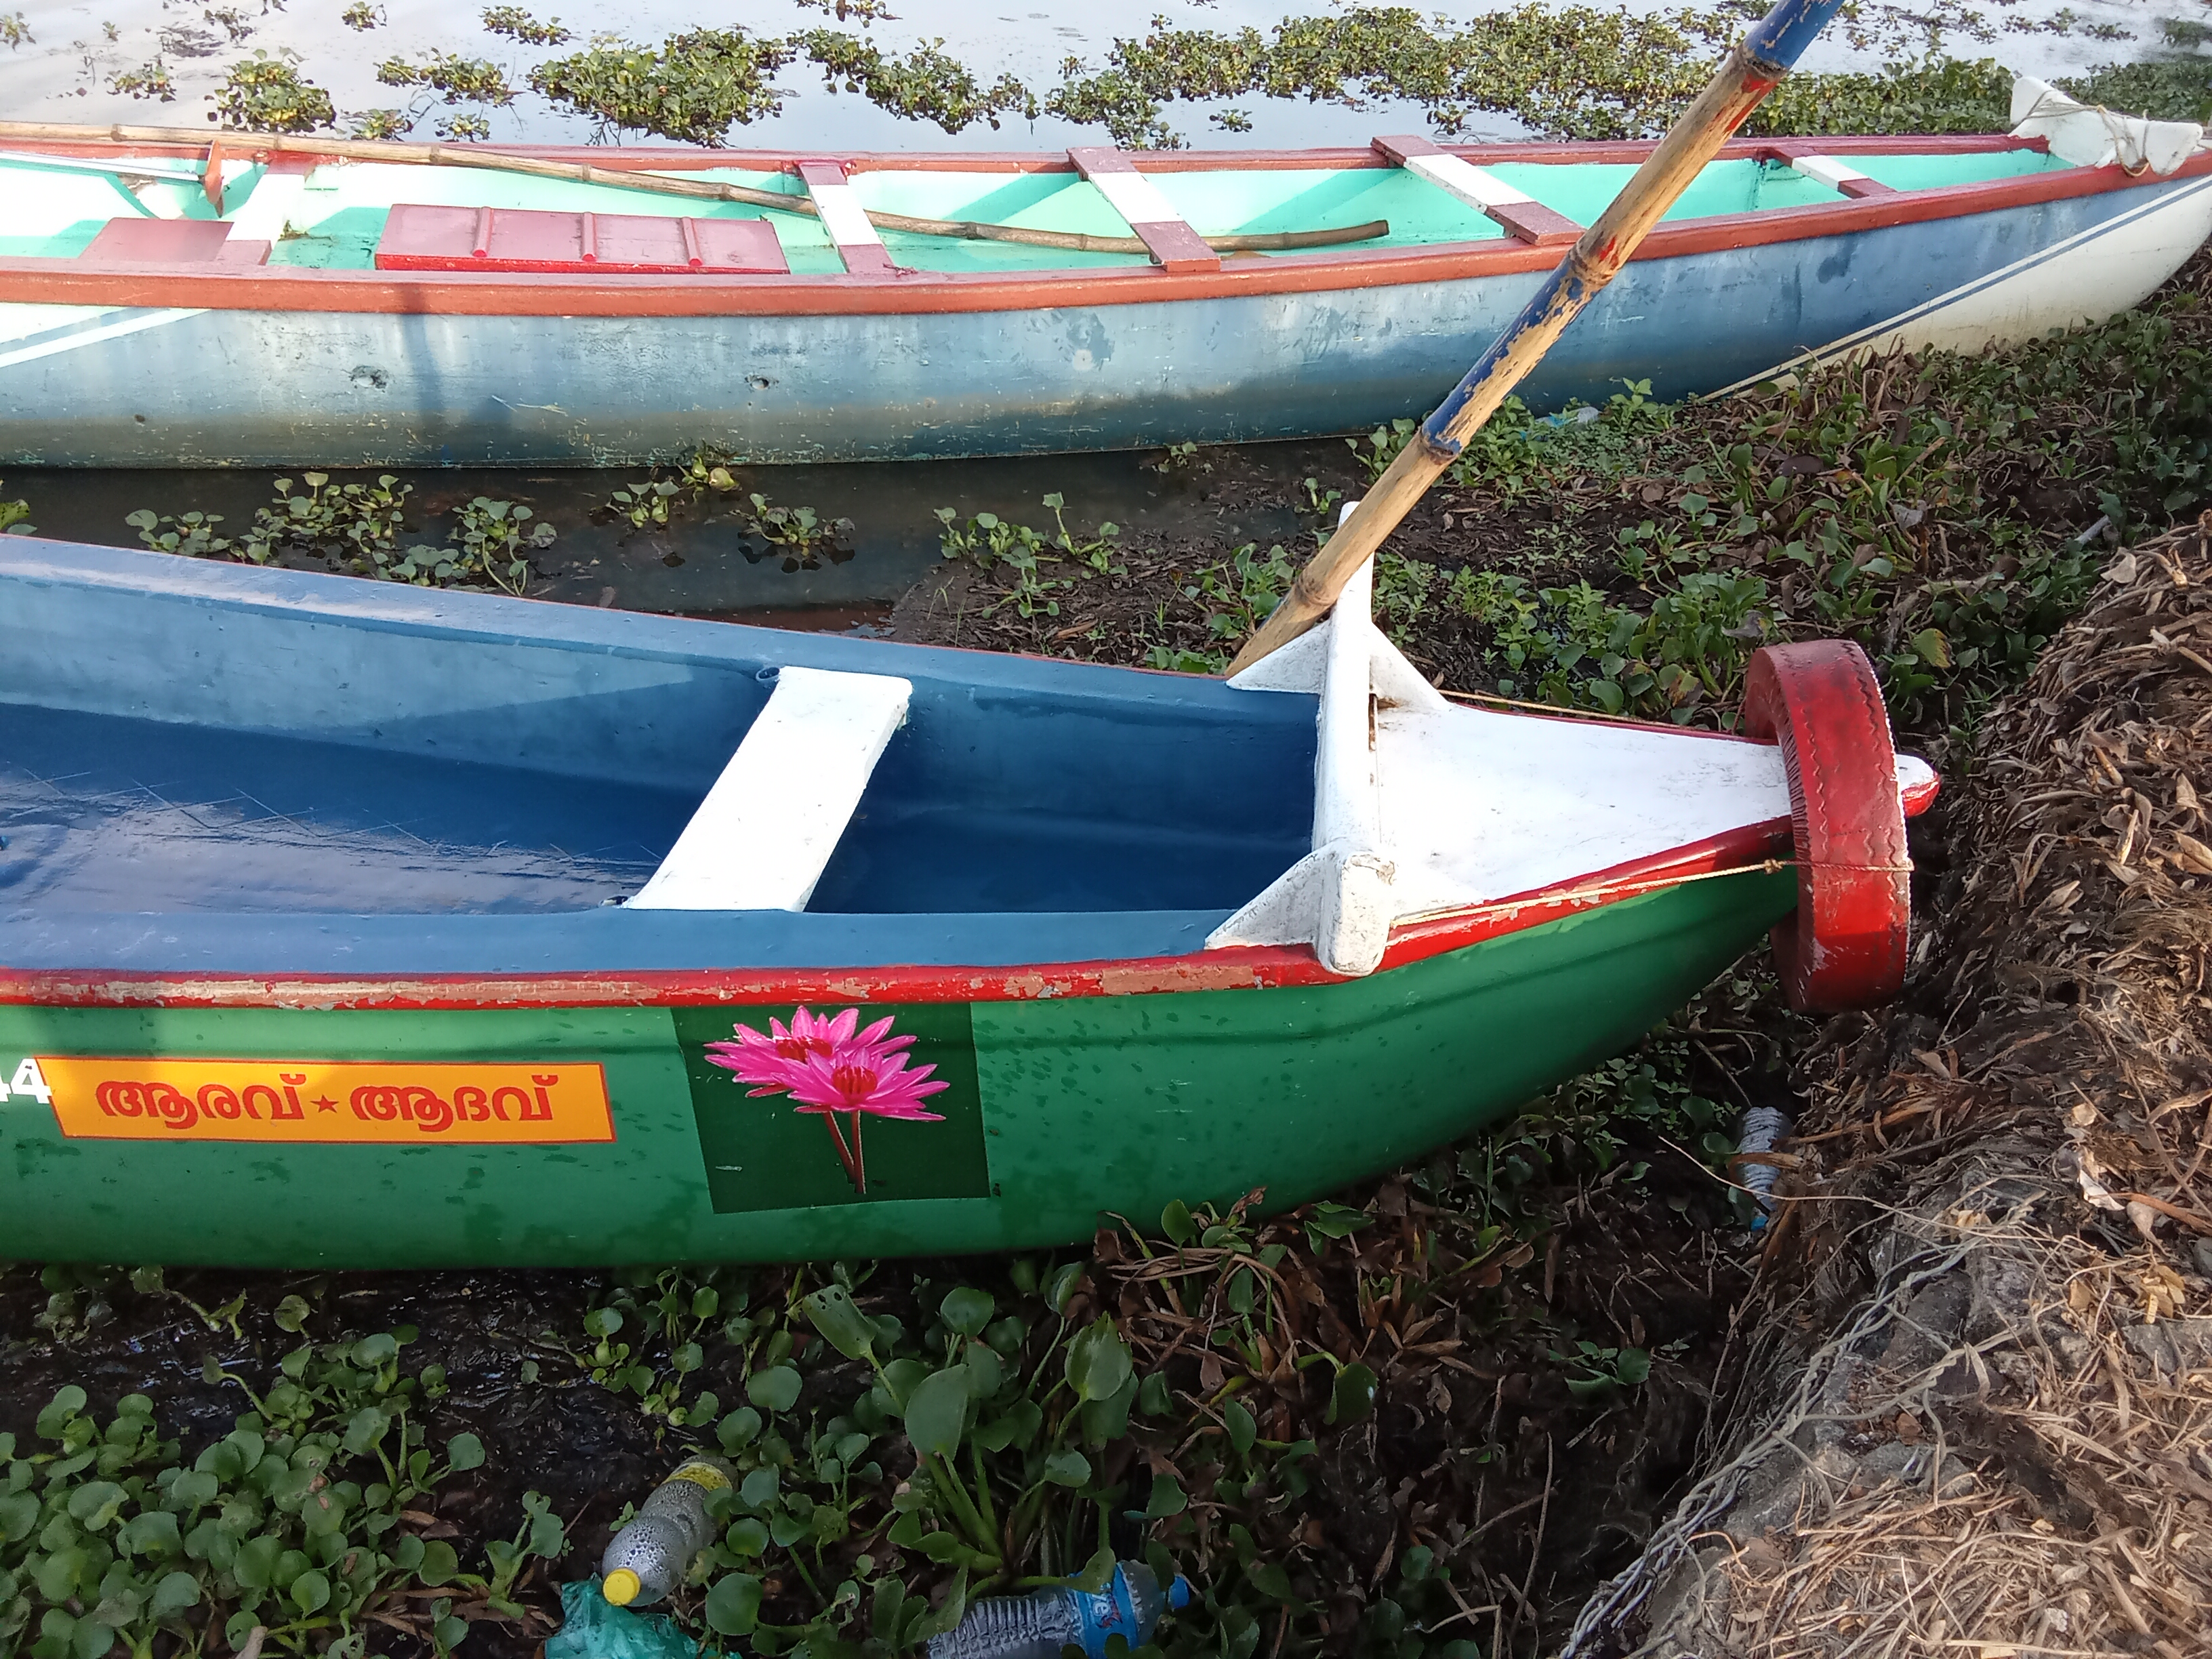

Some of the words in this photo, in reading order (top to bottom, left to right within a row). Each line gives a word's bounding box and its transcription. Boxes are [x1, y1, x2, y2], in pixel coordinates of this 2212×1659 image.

[0, 1058, 53, 1104] 4
[96, 1073, 306, 1130] ആരവ്
[349, 1074, 559, 1132] ആദവ്
